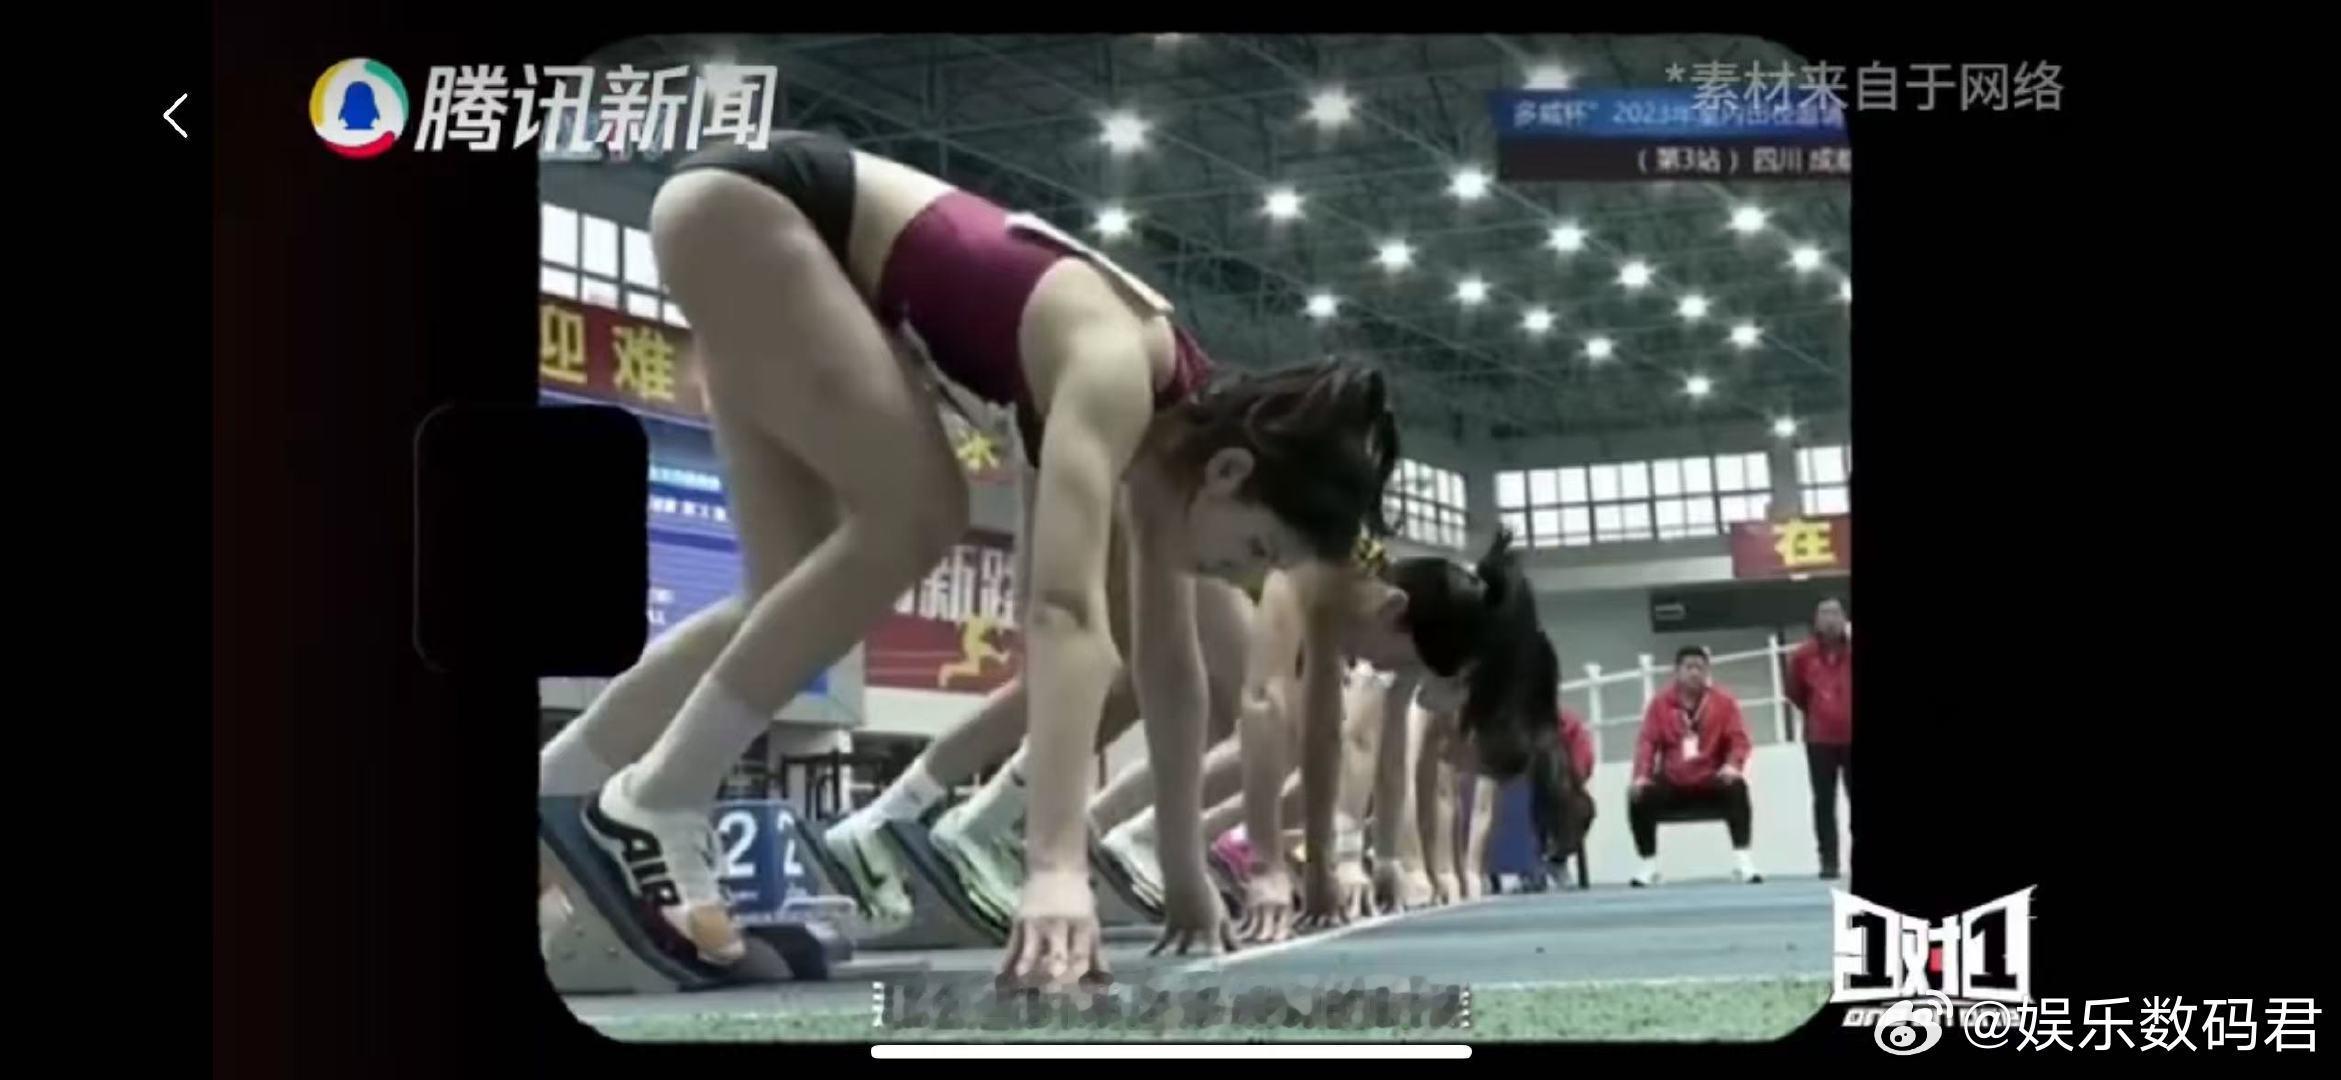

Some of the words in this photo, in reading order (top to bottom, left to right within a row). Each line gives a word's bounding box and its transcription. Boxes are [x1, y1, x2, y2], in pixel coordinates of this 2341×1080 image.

[1772, 518, 1837, 567] 在
[622, 829, 682, 906] AIR
[717, 809, 757, 876] 2
